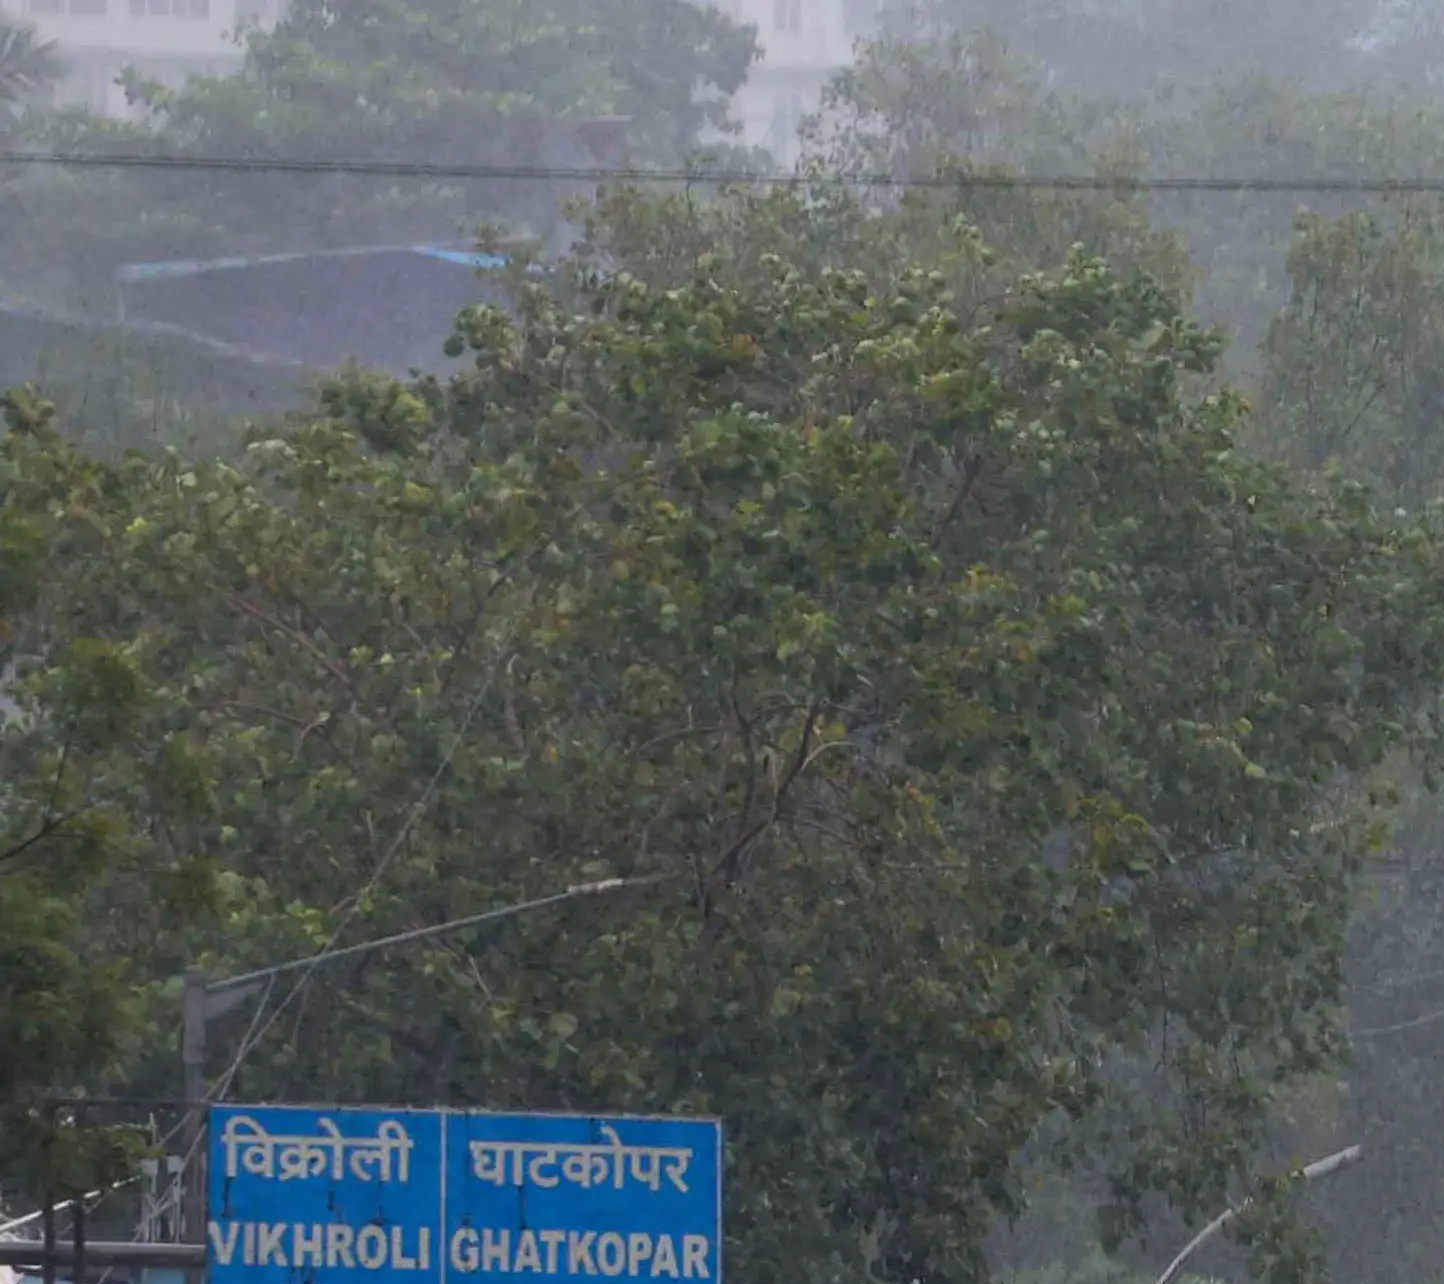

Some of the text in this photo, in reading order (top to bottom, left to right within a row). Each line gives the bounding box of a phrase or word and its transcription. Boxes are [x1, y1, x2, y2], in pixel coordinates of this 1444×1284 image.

[220, 1115, 414, 1184] विक्रोली
[468, 1126, 693, 1194] घाटकोपर
[207, 1220, 431, 1271] VIKHROLI
[449, 1228, 711, 1280] GHATKOPAR
